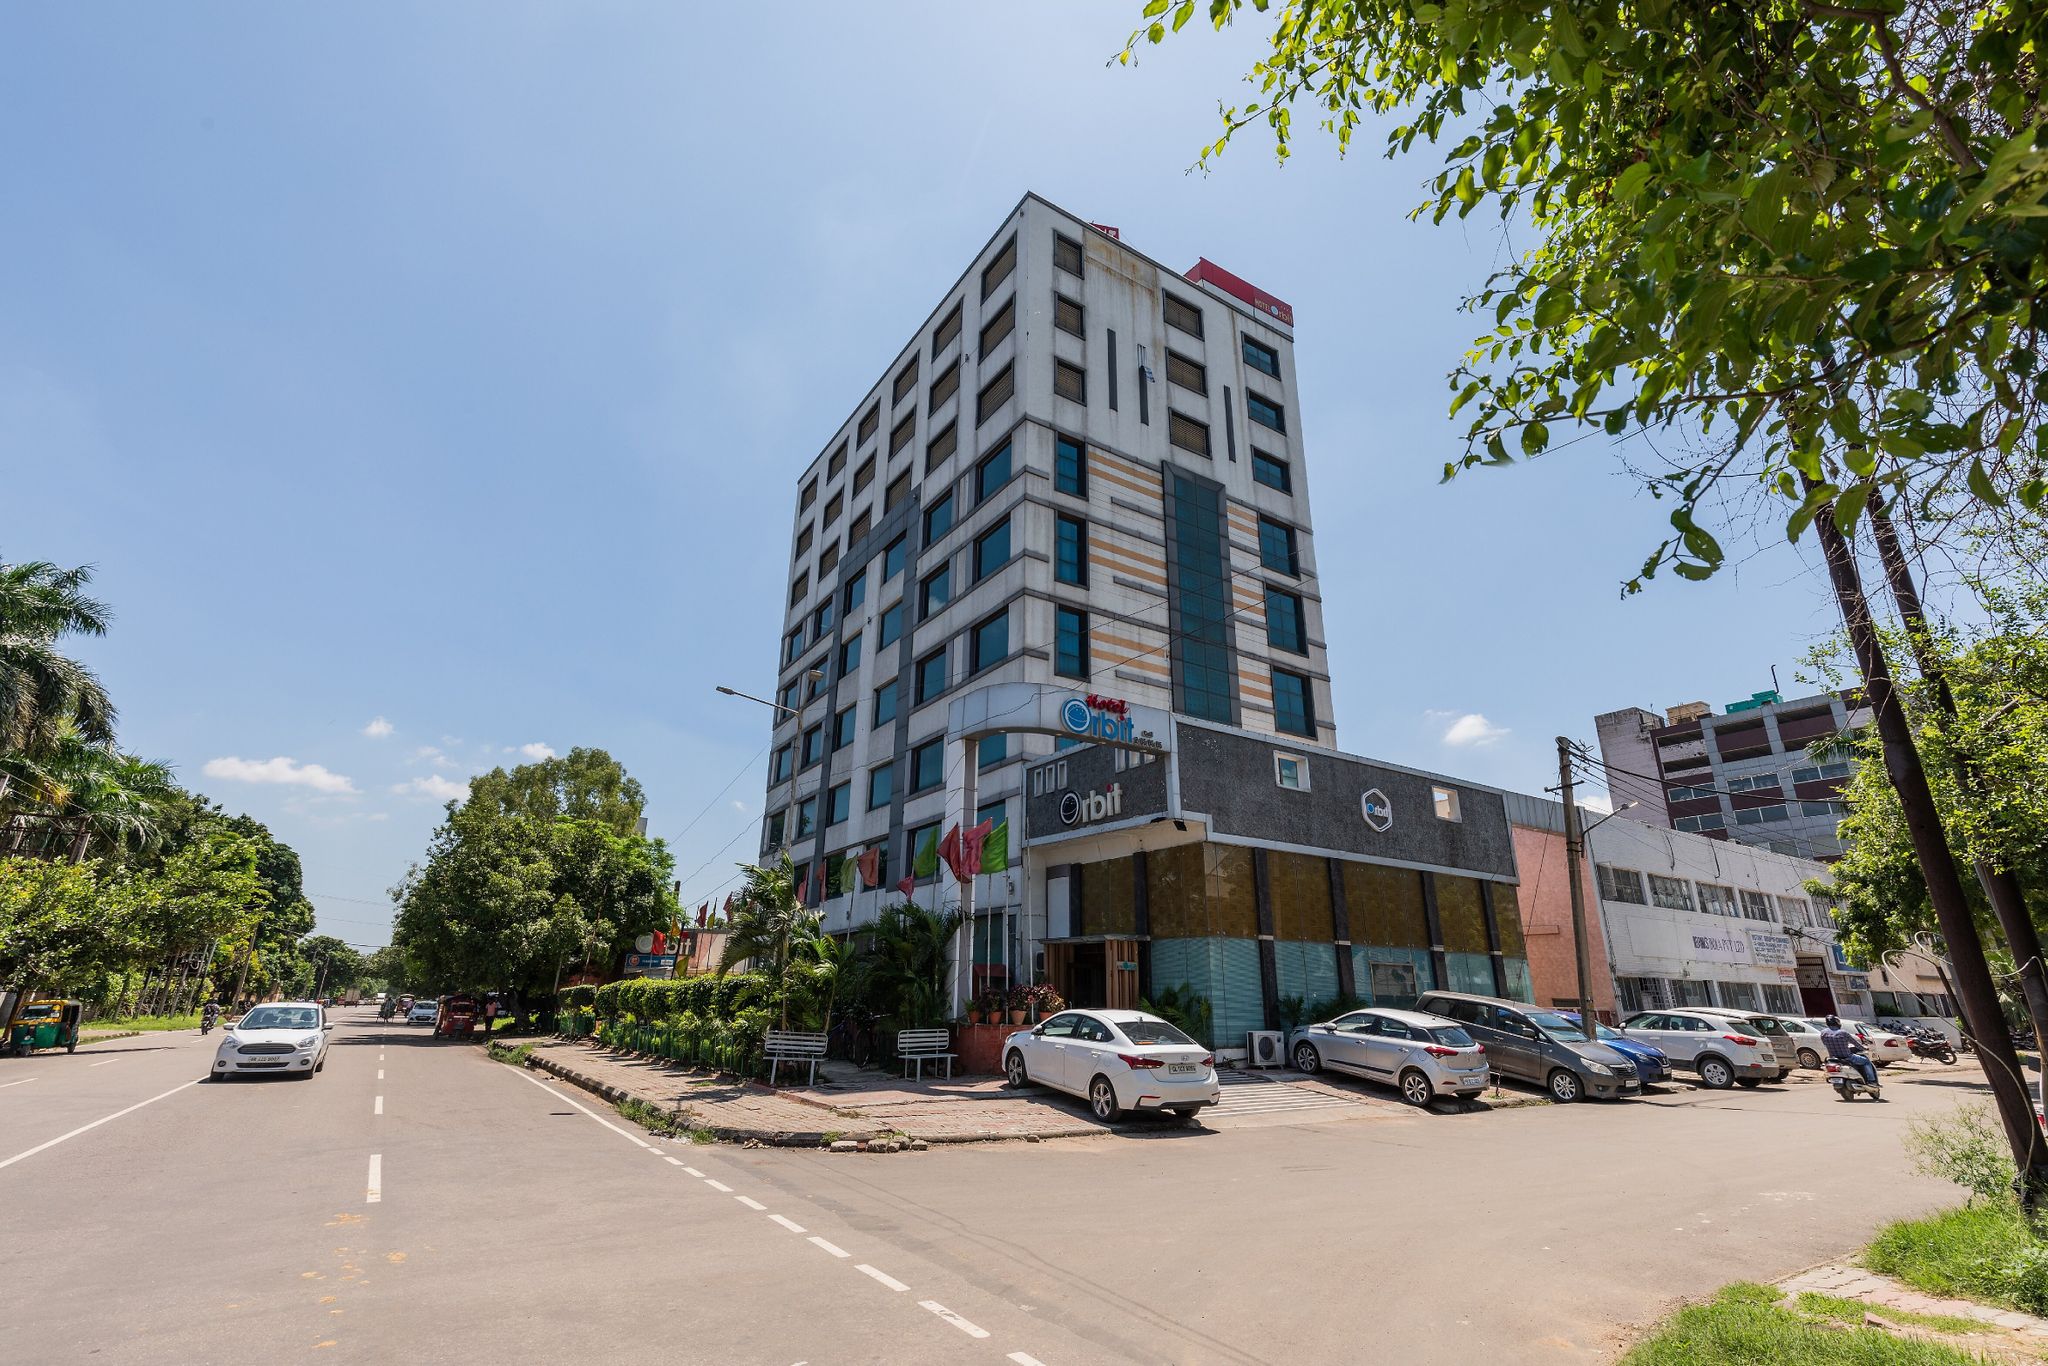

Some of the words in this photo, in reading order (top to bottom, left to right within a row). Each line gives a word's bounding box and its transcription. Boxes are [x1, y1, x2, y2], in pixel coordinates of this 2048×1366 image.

[1255, 297, 1271, 312] HOTEL
[1085, 694, 1130, 714] Hotel
[1061, 698, 1134, 743] Orbit
[1060, 782, 1123, 826] Orbit
[1367, 803, 1389, 818] Orbit
